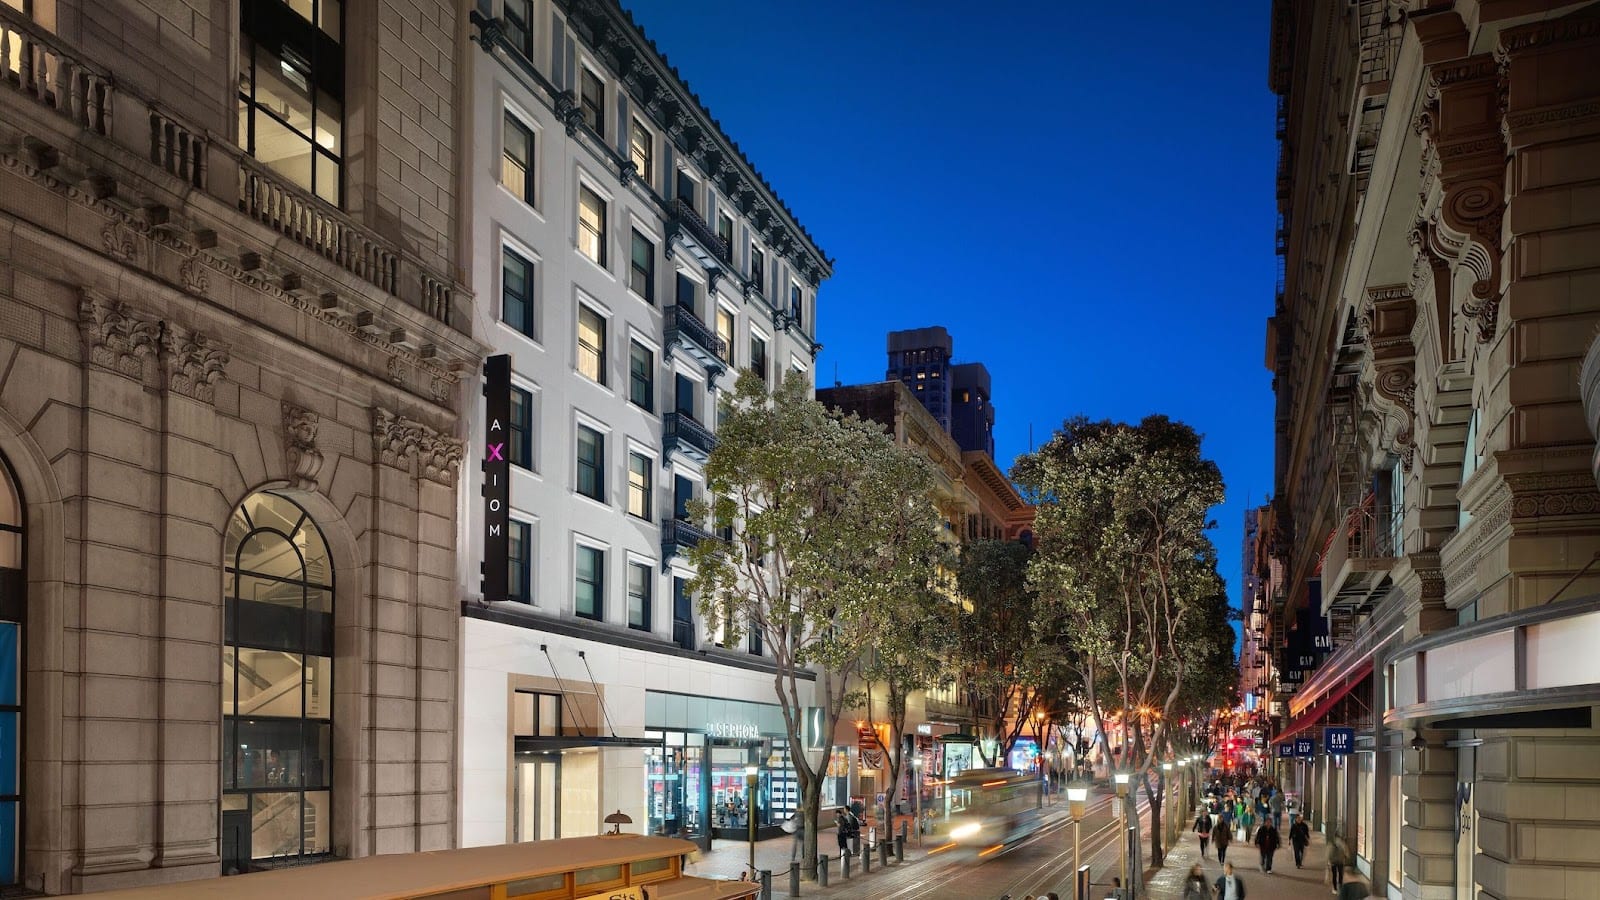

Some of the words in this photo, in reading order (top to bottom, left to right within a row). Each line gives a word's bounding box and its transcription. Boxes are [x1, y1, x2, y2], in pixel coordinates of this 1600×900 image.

[488, 419, 504, 537] AXIOM
[1300, 656, 1313, 666] GAP
[1290, 671, 1301, 680] GAP
[716, 722, 760, 738] SEPHORA
[1332, 734, 1347, 744] GAP
[1299, 745, 1310, 753] GAP
